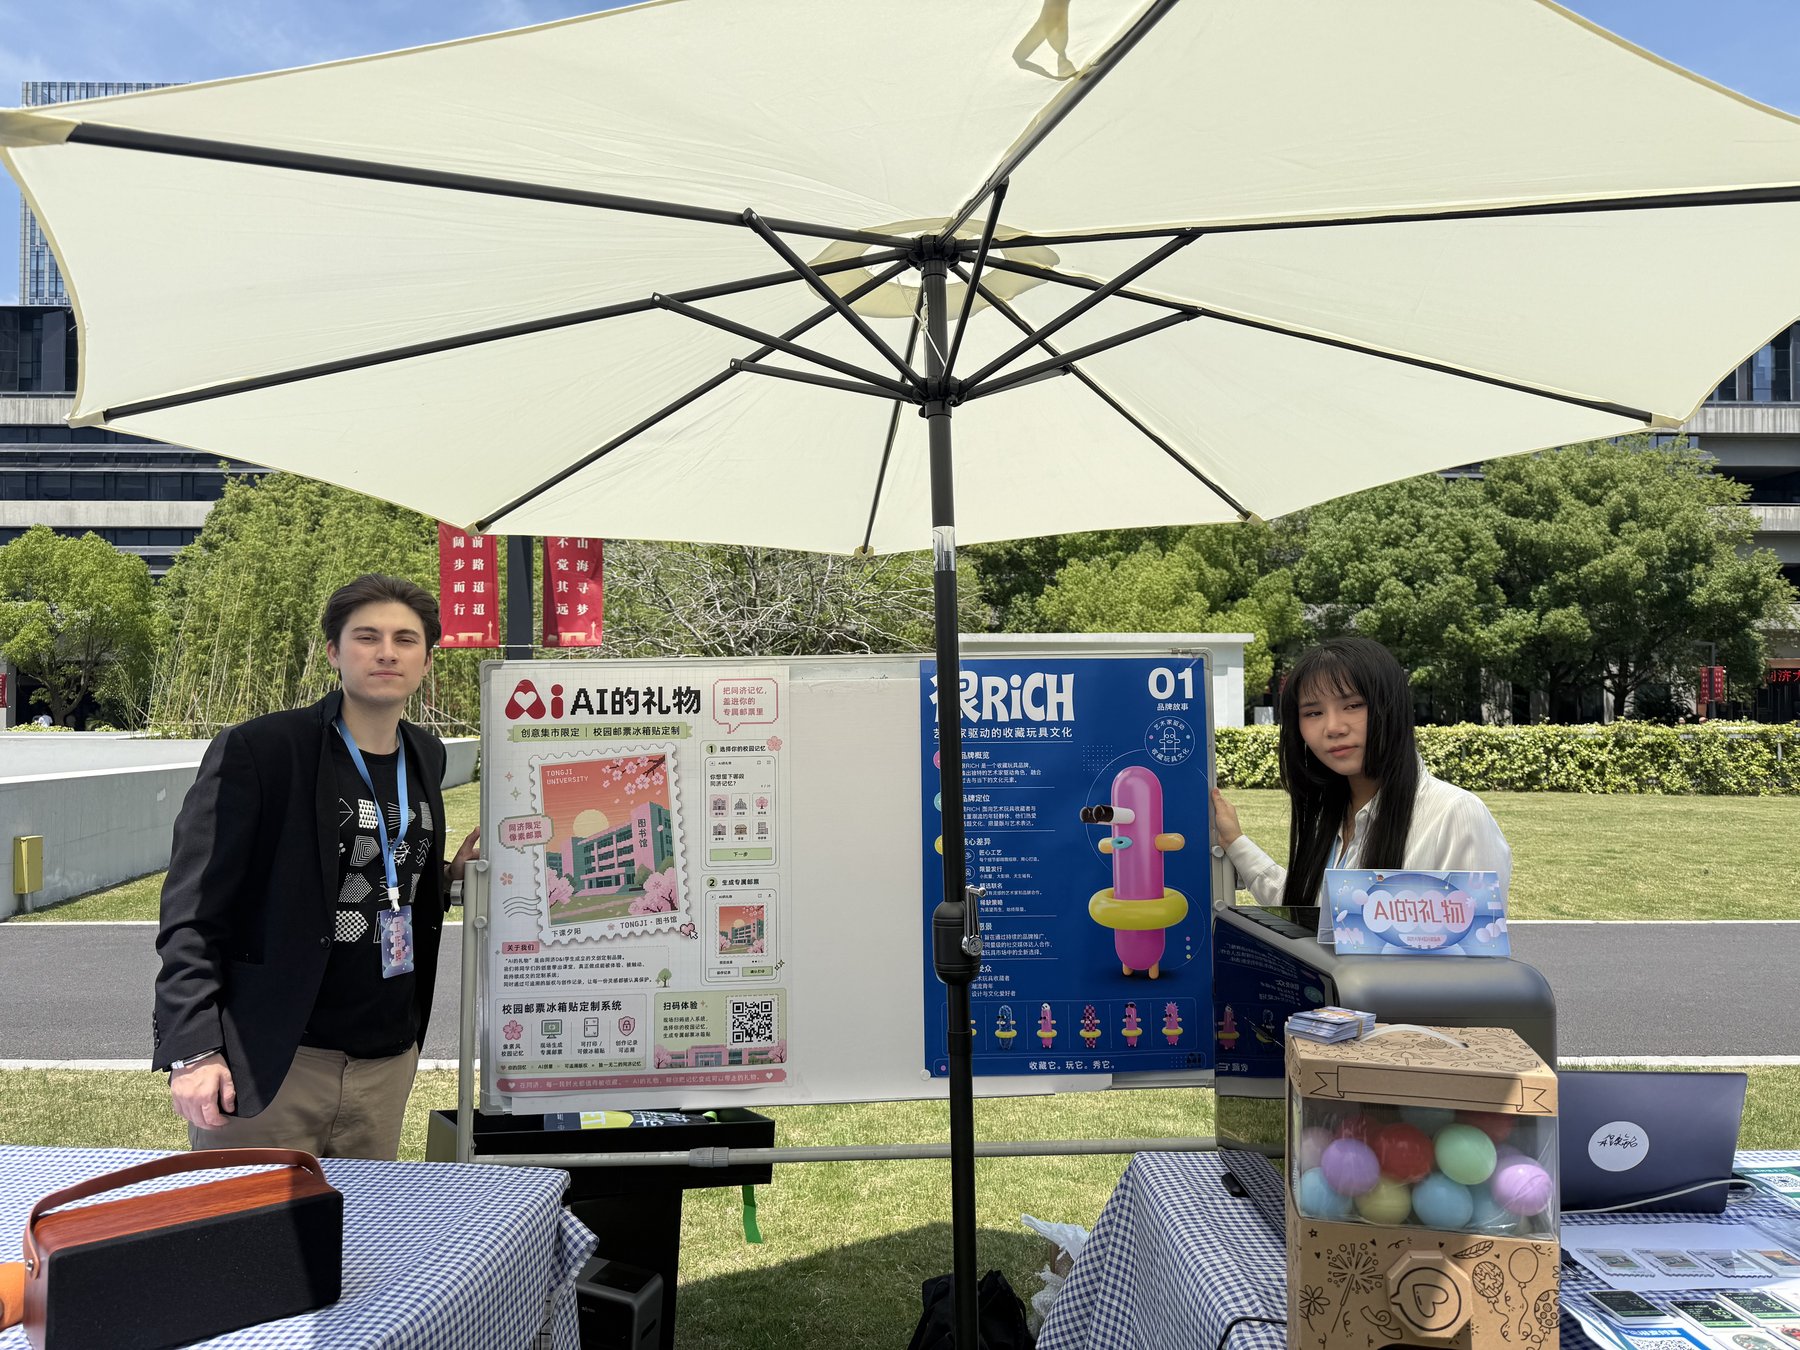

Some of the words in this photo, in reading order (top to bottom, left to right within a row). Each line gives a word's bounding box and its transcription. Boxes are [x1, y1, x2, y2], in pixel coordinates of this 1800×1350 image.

[452, 536, 466, 616] 阔步而行
[471, 535, 485, 616] 前路迢迢
[576, 538, 589, 616] 山海寻梦
[1148, 667, 1194, 700] 01
[570, 686, 701, 716] AI的礼物
[723, 697, 756, 706] 盖进你的
[1157, 702, 1189, 711] 品牌故事
[723, 708, 764, 716] 专属邮票里
[521, 726, 580, 739] 创意集市限定
[593, 725, 680, 737] 校园邮票冰箱贴定制
[933, 726, 1073, 739] 艺家驱动的收藏玩具文化
[719, 745, 766, 753] 选择你的校园记忆
[546, 768, 573, 777] TONGJI
[546, 775, 589, 785] UNIVERSITY
[508, 820, 542, 832] 同济限定
[508, 830, 543, 841] 像素邮票
[637, 818, 648, 848] 图书馆
[721, 878, 760, 886] 生成专属邮票
[1374, 899, 1466, 924] AI的礼物
[551, 926, 582, 938] 下课夕阳
[620, 919, 648, 929] TONGJI
[655, 915, 677, 925] 图书馆
[507, 944, 535, 952] 关于我们
[502, 1000, 622, 1015] 校园邮票冰箱贴定制系统
[663, 1000, 699, 1011] 扫码体验
